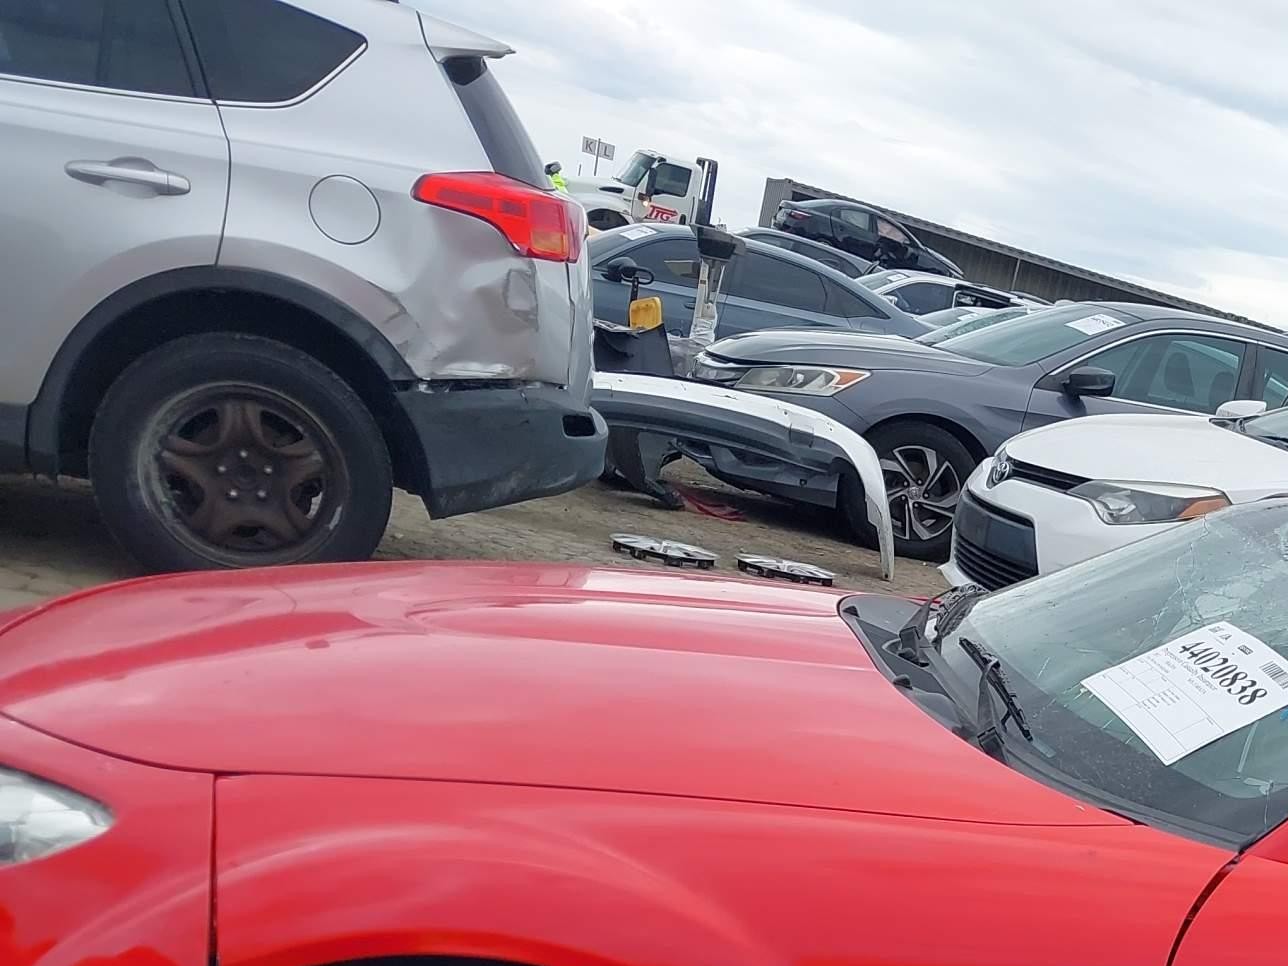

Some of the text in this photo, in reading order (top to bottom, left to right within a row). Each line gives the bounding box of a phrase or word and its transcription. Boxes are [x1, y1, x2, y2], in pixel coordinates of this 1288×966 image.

[585, 140, 594, 153] K
[603, 145, 610, 158] L
[1179, 641, 1268, 705] 44020838
